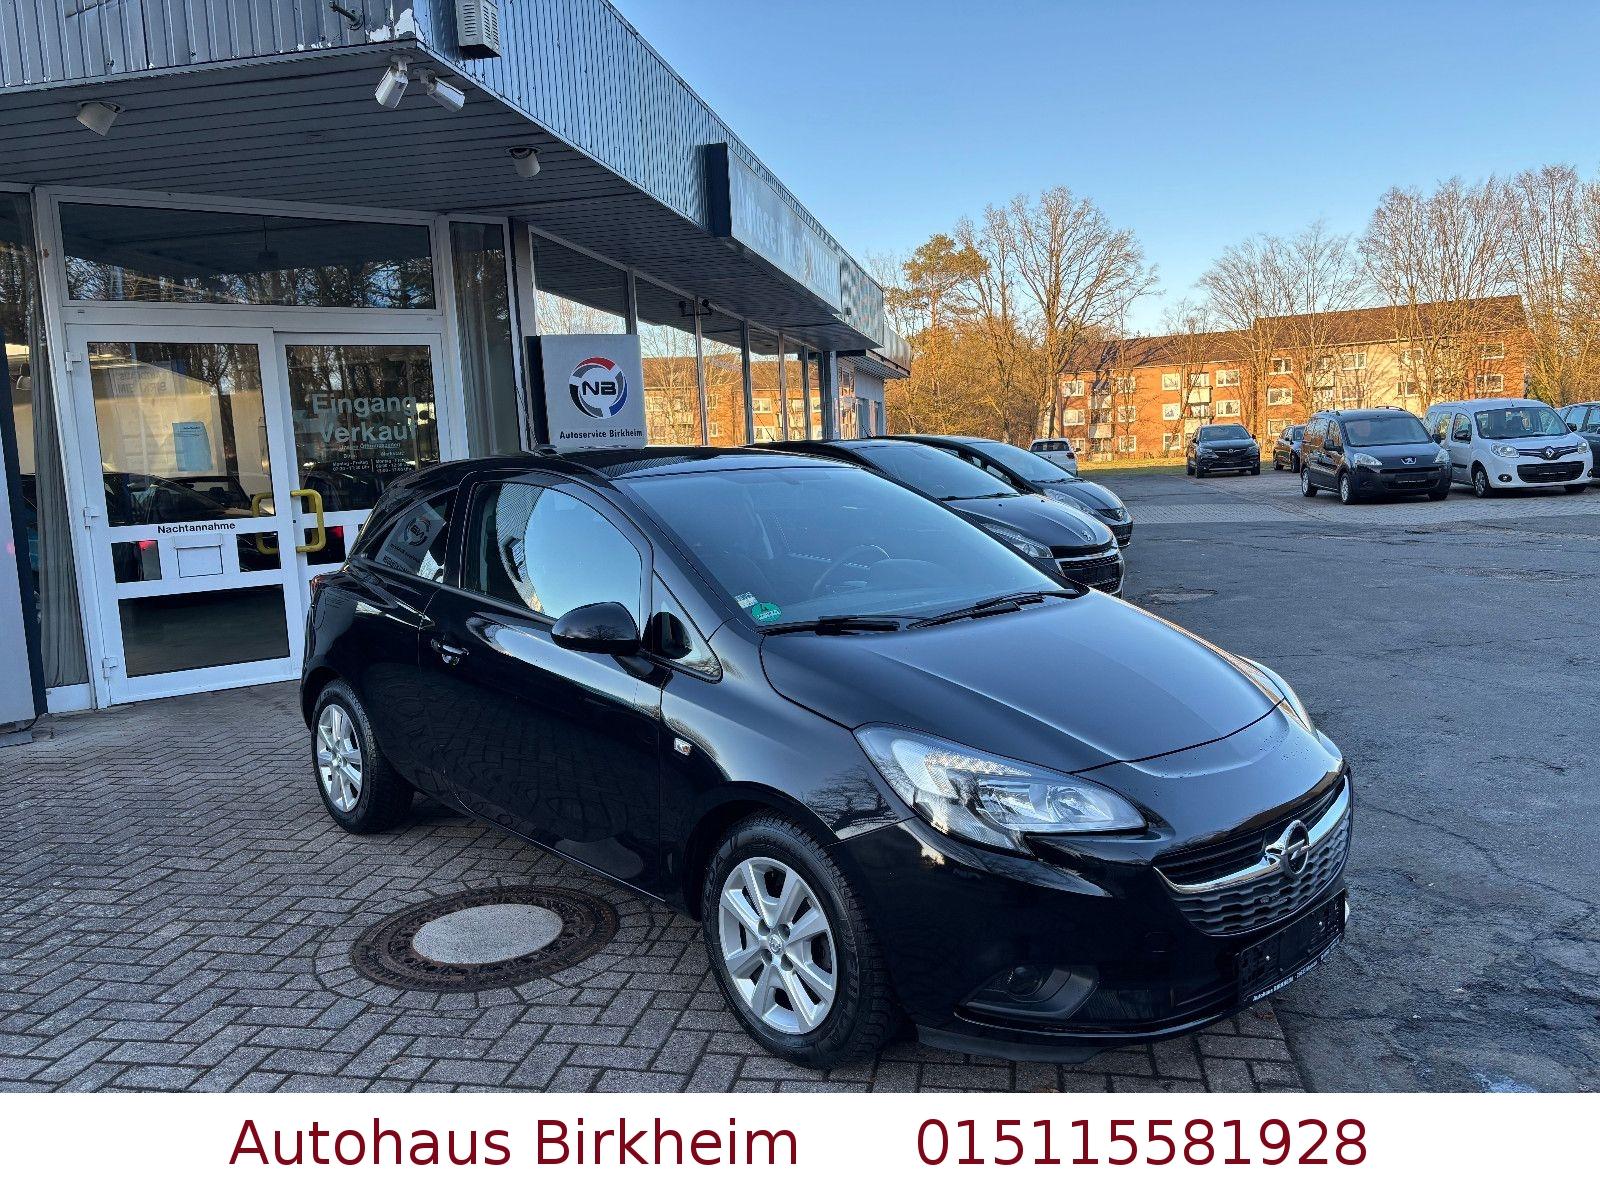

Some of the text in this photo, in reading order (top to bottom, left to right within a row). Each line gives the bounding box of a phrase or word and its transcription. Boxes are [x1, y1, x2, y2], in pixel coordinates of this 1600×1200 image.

[582, 381, 617, 396] NB
[312, 393, 416, 417] Eingang
[560, 428, 643, 440] Autoservice Birkheim
[157, 522, 236, 534] Nachtannahme
